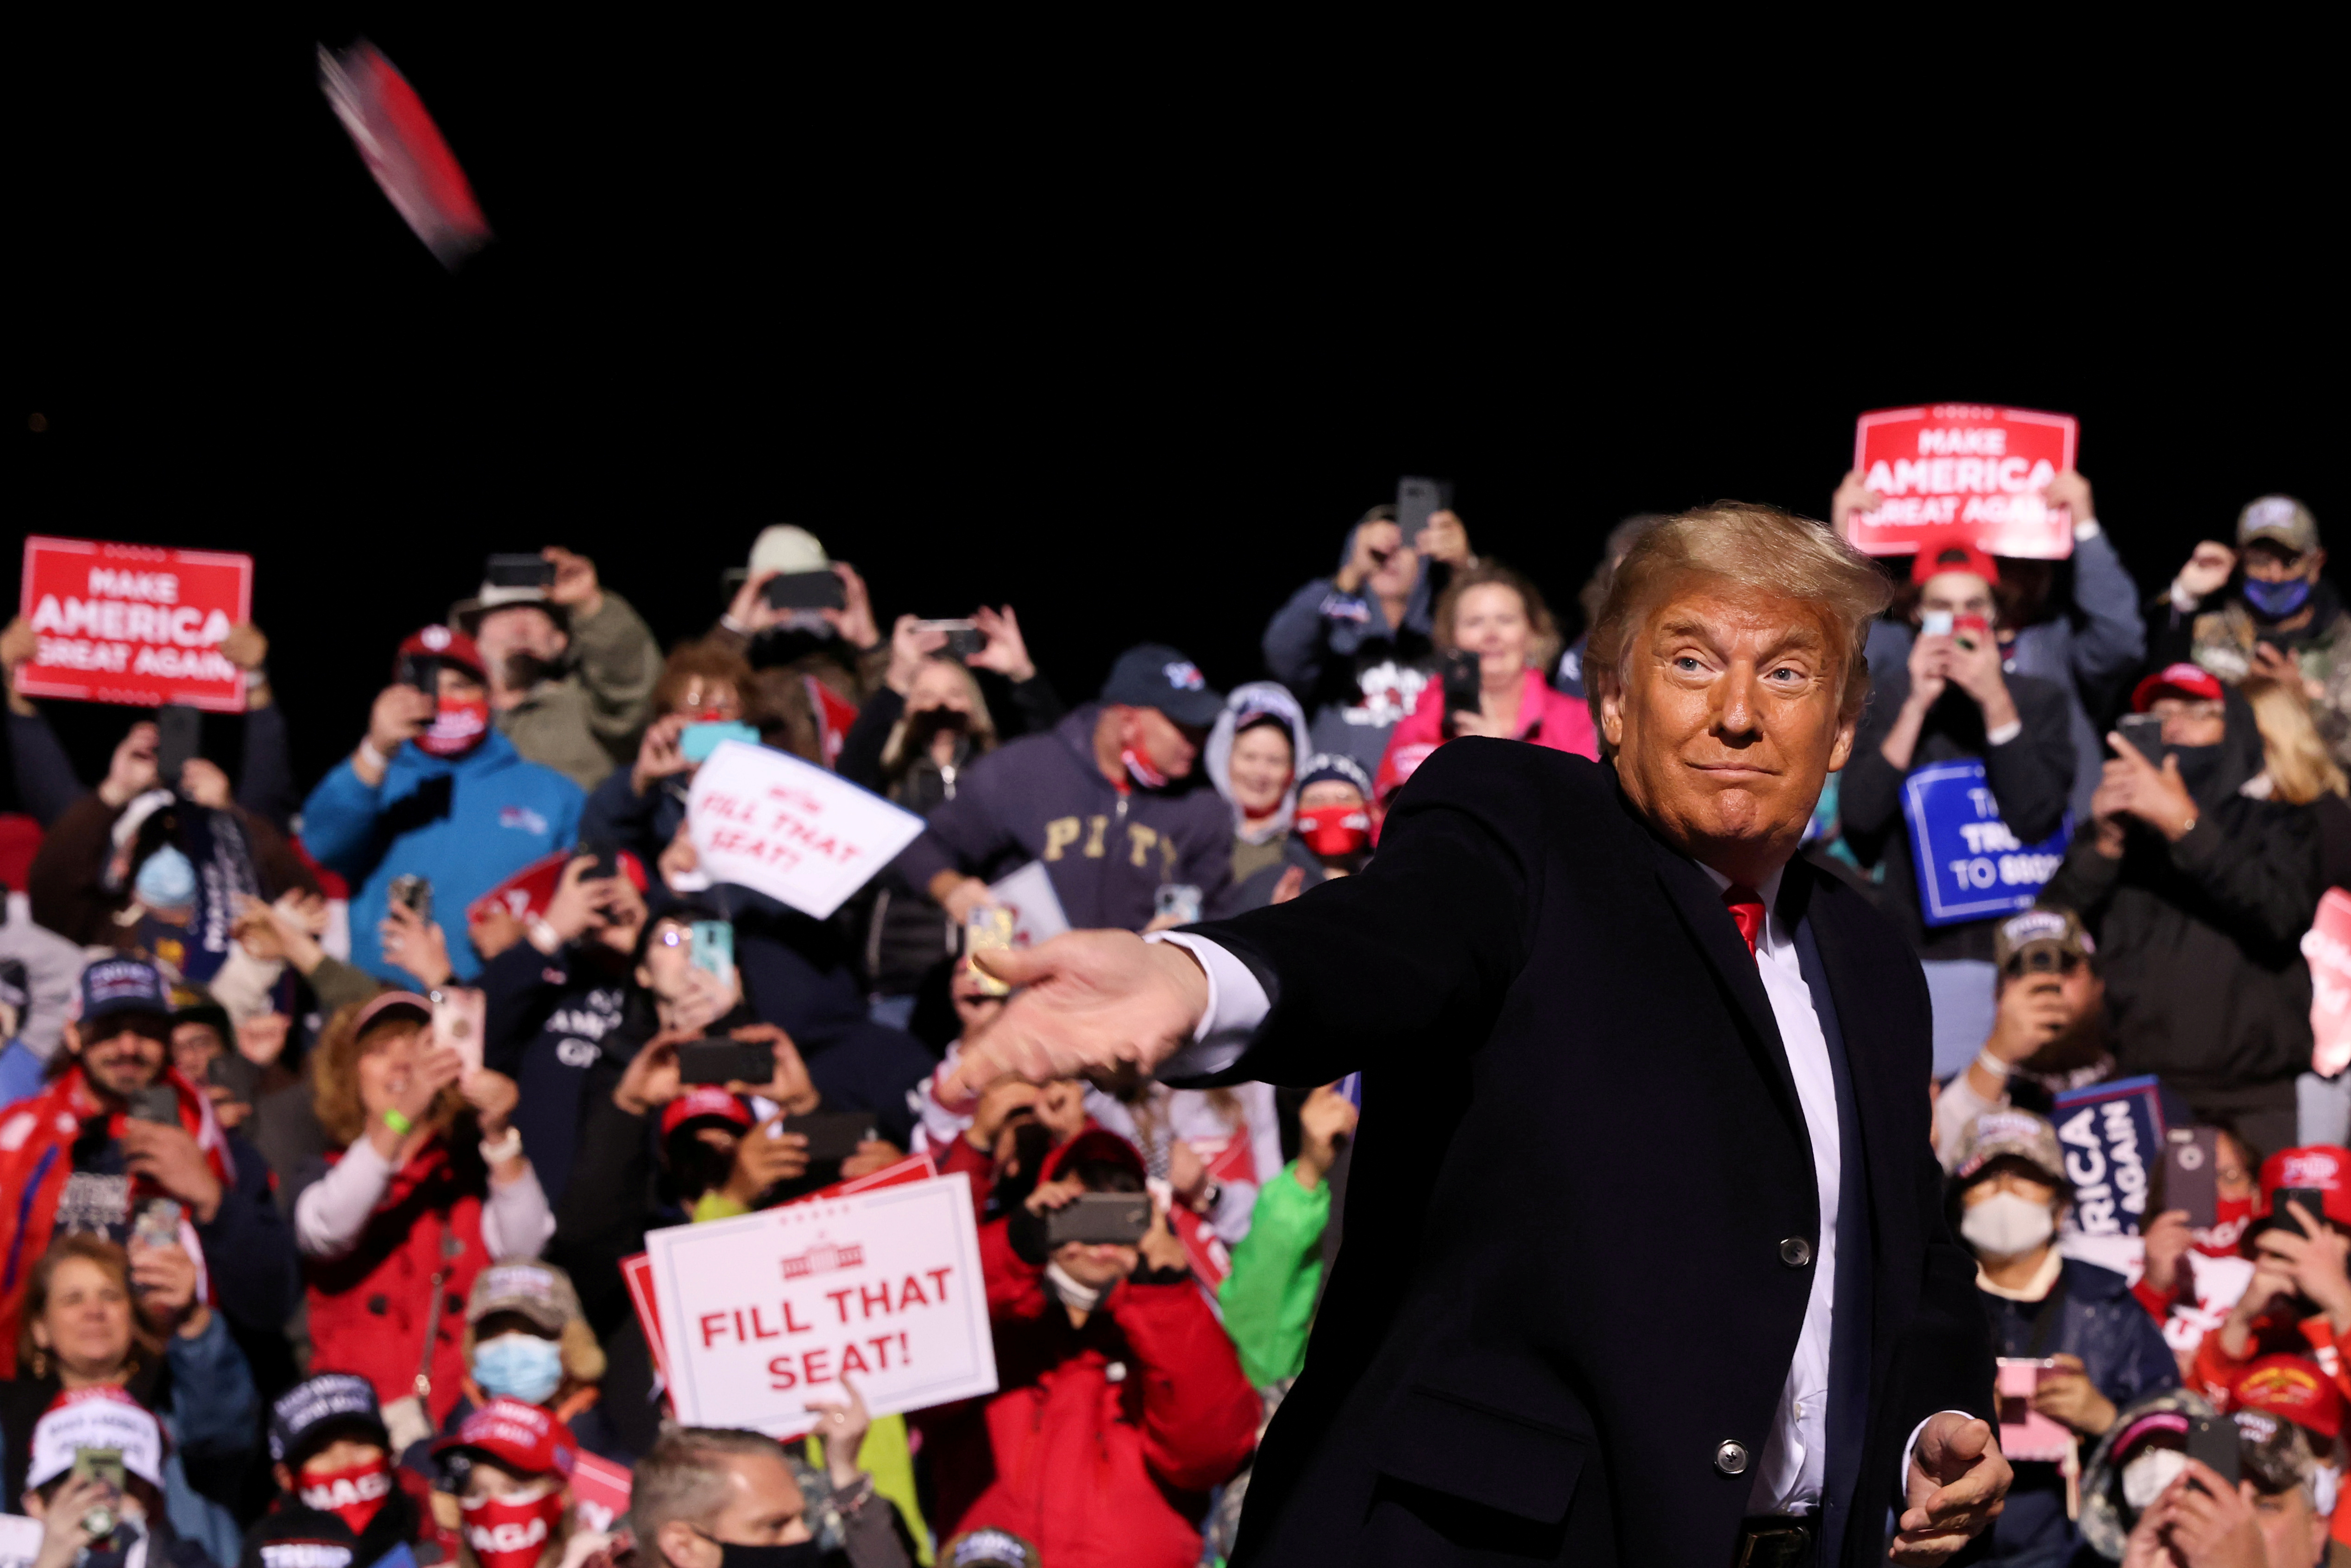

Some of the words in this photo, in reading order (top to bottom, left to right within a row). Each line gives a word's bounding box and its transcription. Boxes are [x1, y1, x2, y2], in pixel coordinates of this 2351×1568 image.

[1918, 428, 2007, 456] MAKE
[1864, 457, 2055, 495] AMERICA
[88, 566, 179, 604] MAKE
[31, 594, 231, 647] AMERICA
[1949, 857, 1997, 891] TO
[2057, 1107, 2120, 1233] RICA
[698, 1298, 813, 1348] FILL
[825, 1265, 953, 1324] THAT
[766, 1331, 912, 1391] SEAT!
